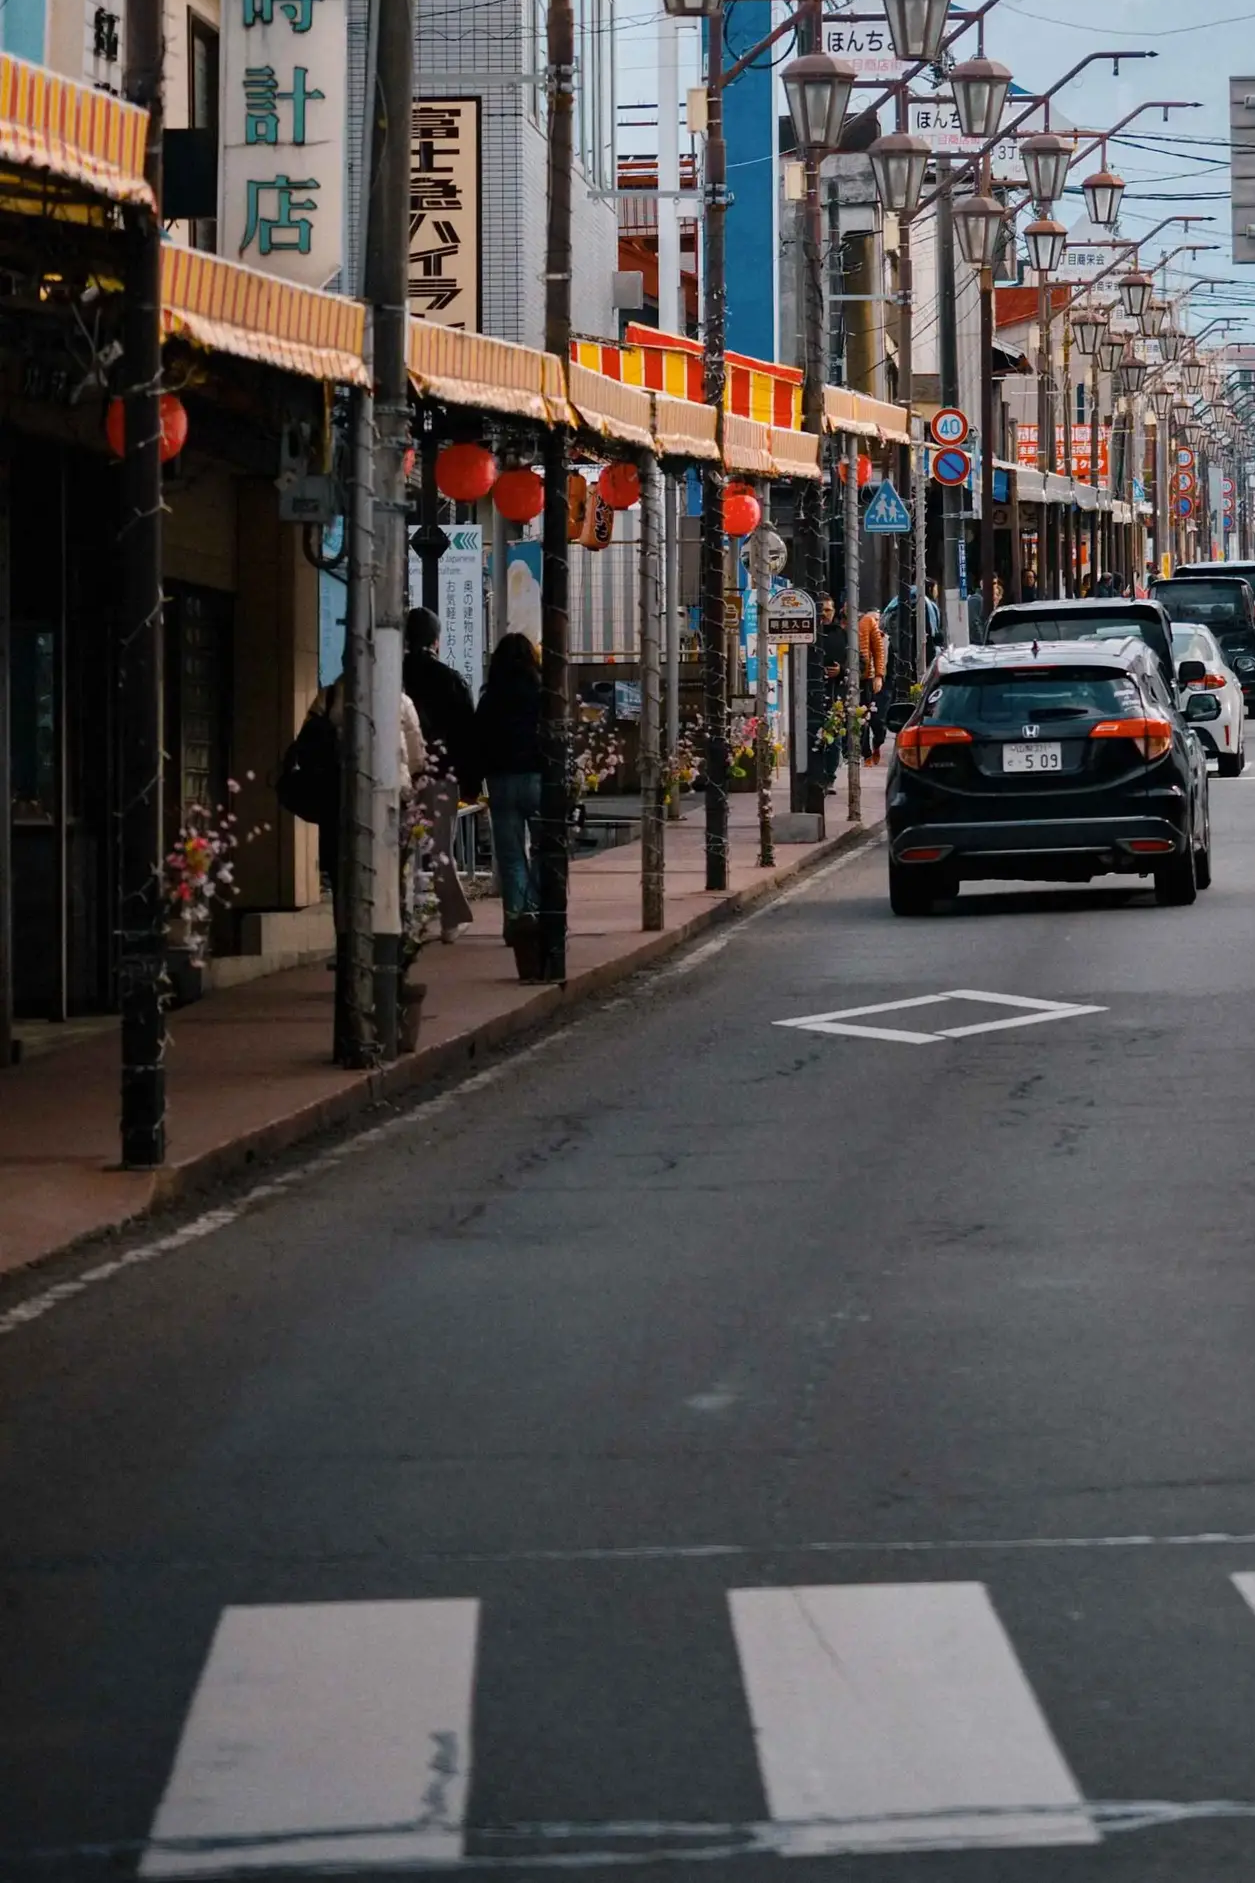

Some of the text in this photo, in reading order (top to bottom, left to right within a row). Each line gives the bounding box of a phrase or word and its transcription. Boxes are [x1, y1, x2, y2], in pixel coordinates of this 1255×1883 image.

[997, 144, 1021, 160] 3丁
[409, 106, 465, 330] 富士急ハイラ
[940, 419, 961, 436] 40
